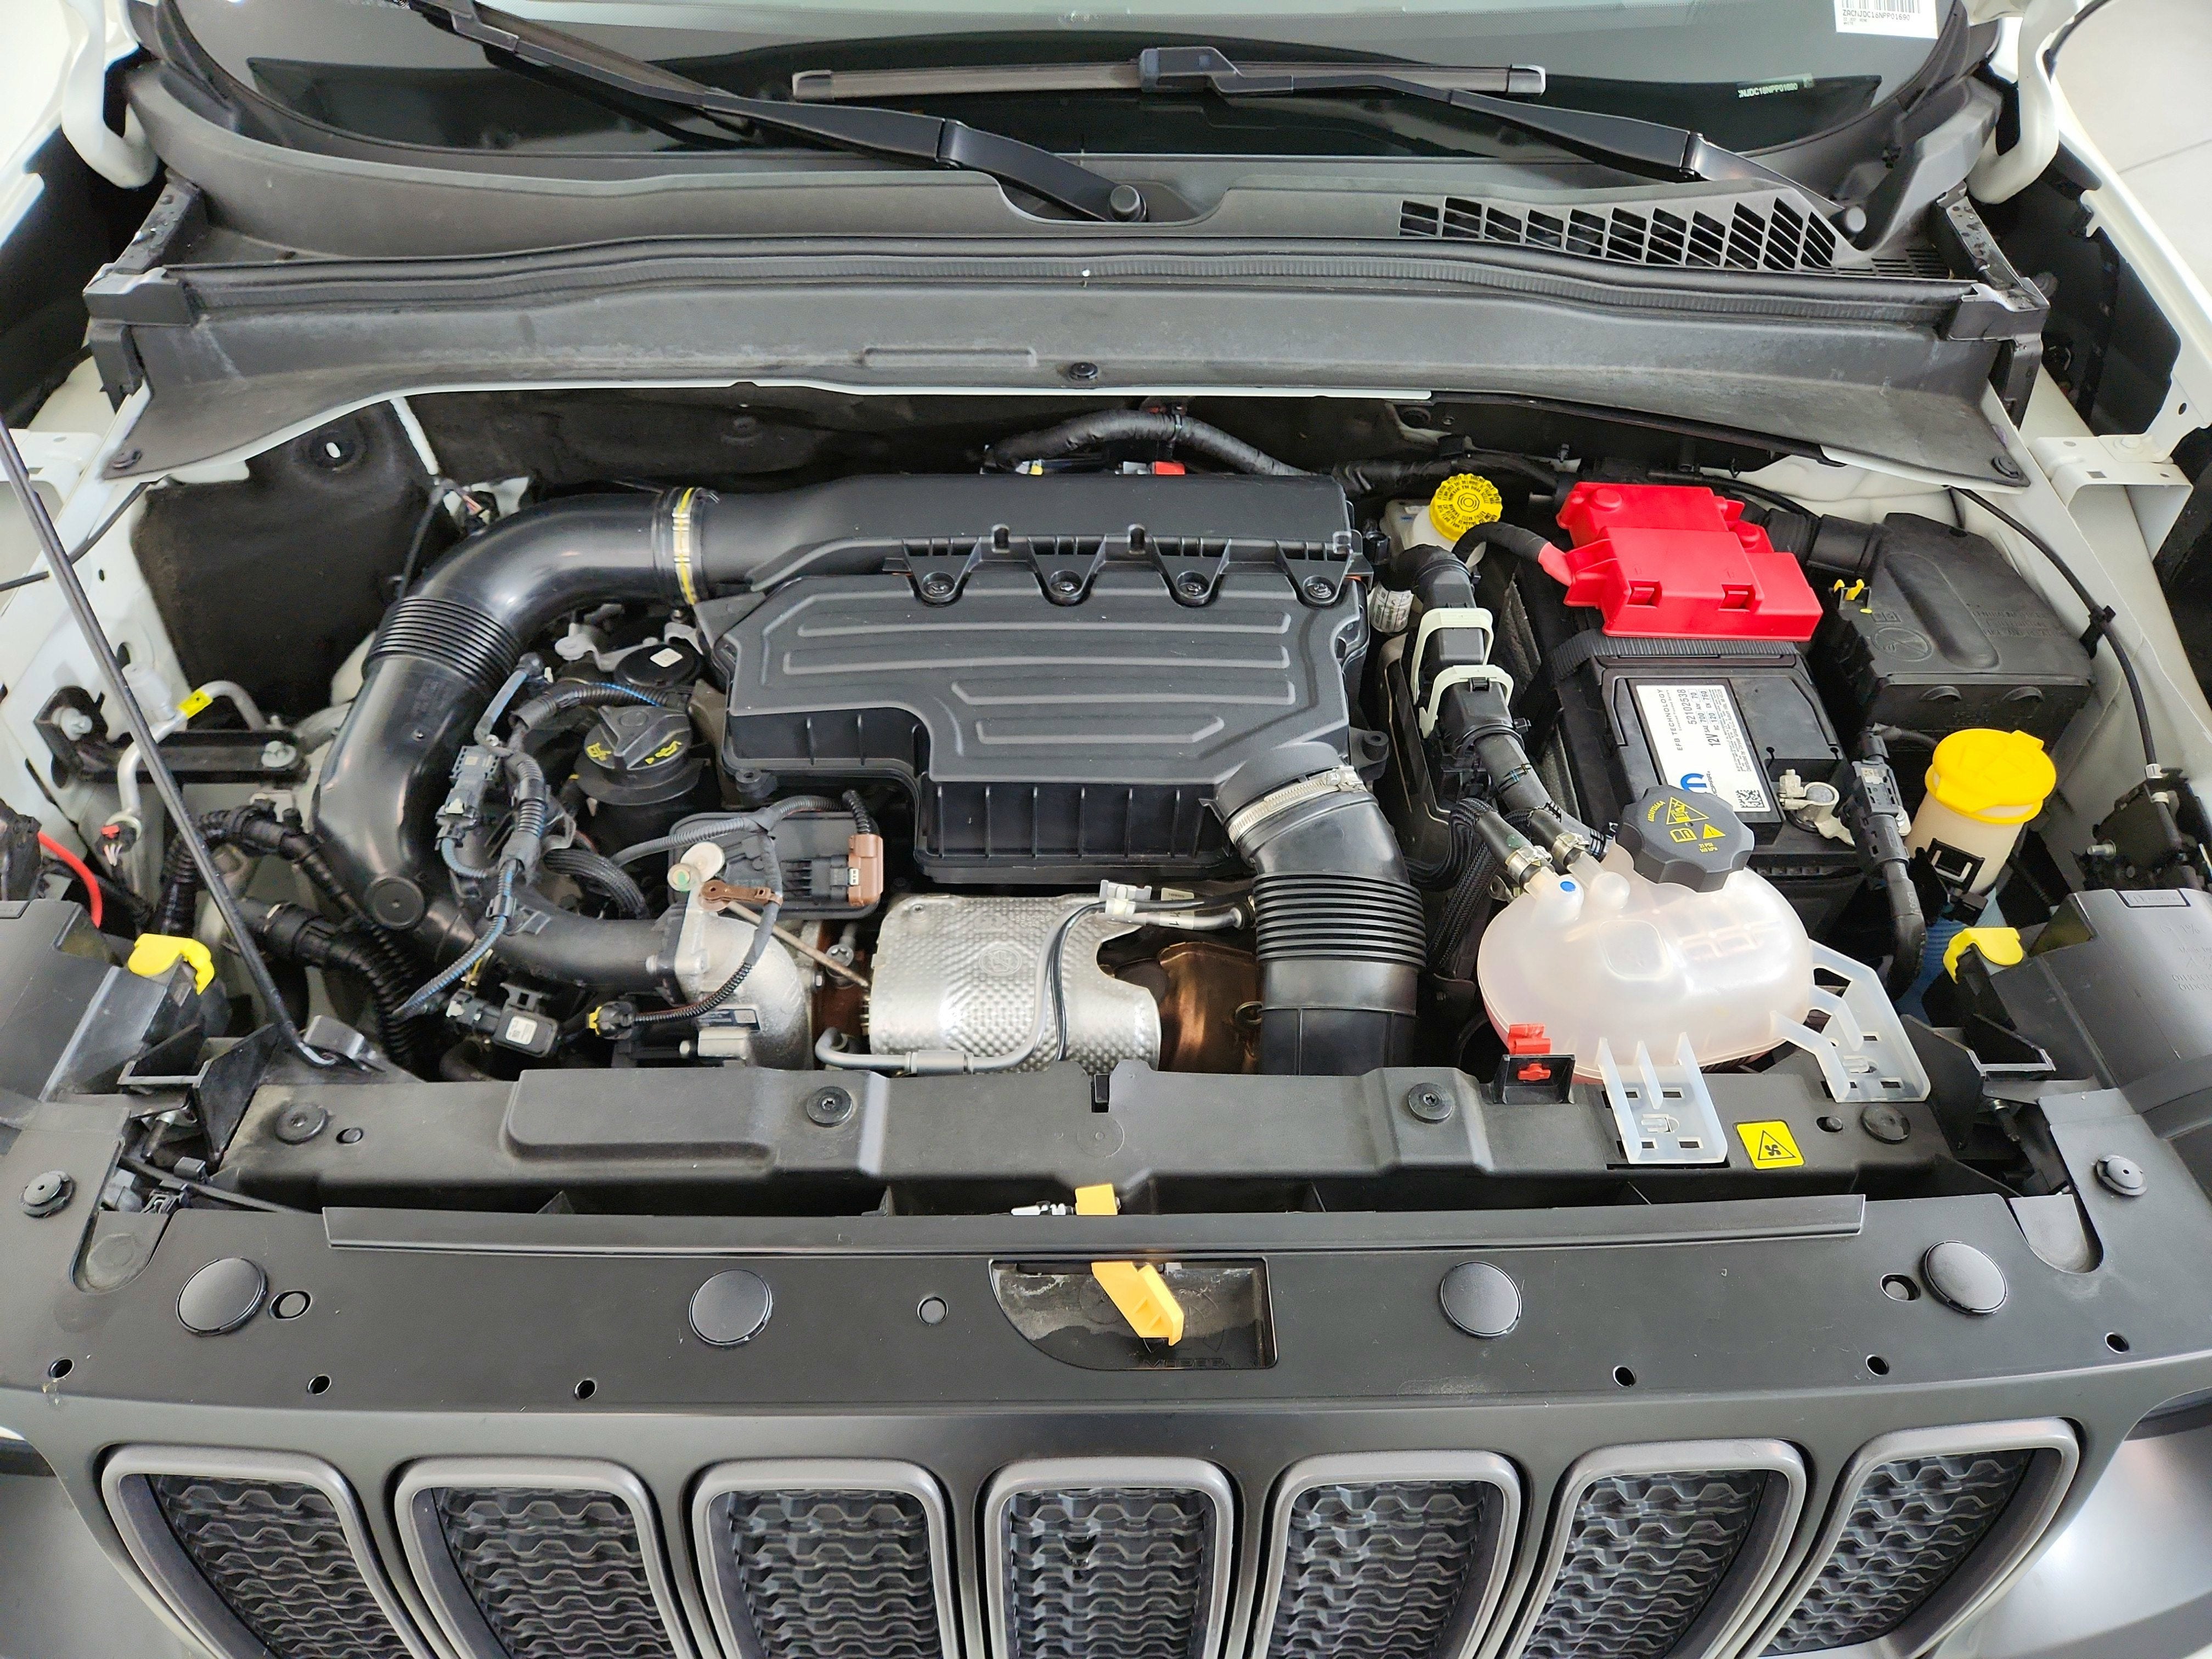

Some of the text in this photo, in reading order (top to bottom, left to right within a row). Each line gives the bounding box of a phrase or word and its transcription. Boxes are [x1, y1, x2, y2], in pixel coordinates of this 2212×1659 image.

[1701, 691, 1710, 700] 760
[1677, 689, 1697, 725] 52102538
[1657, 689, 1683, 751] EFB TECHNOLOGY
[1697, 713, 1707, 723] 700
[1708, 713, 1717, 723] 120
[1705, 734, 1721, 746] 12V
